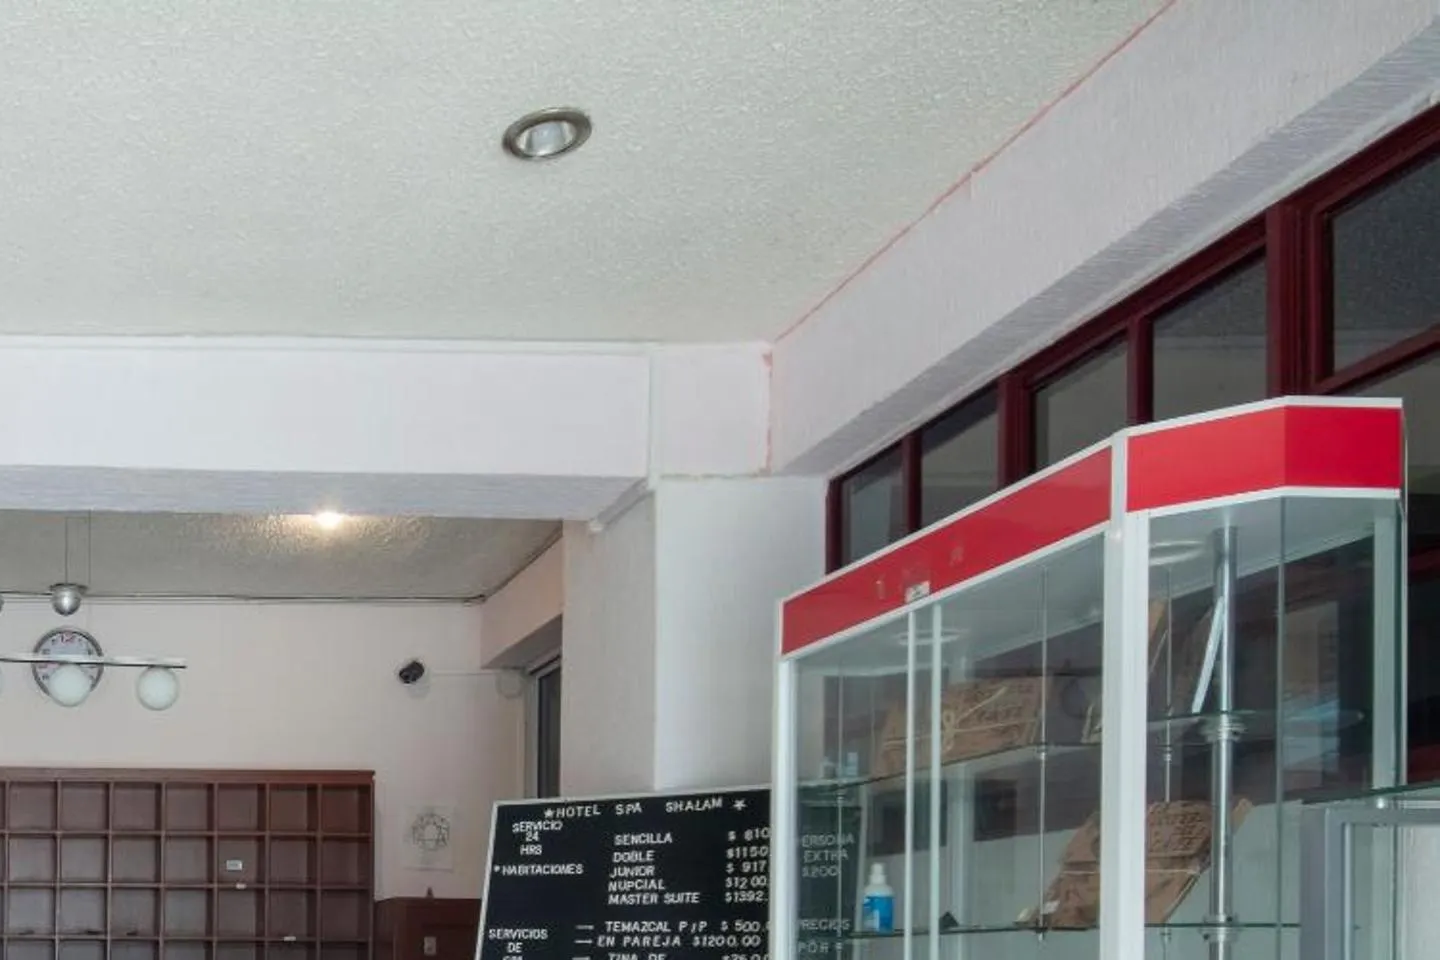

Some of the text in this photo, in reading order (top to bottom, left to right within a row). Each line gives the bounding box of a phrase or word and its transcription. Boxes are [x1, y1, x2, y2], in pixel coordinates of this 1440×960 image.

[556, 798, 723, 818] HOTEL SPA SHALAM
[512, 820, 563, 833] SERVICIO
[613, 832, 673, 846] SENCILLA
[612, 850, 655, 863] DOBLE
[502, 863, 584, 876] HABITACIONES
[609, 865, 656, 878] JUNIOR
[608, 879, 666, 892] NUPCIAL
[608, 892, 658, 905] MASTER
[664, 892, 700, 904] SUITE
[605, 921, 671, 933] TEMAZCAL
[488, 928, 549, 940] SERVICIOS
[507, 942, 523, 953] DE
[597, 935, 615, 948] EN
[623, 935, 681, 948] PAREJA
